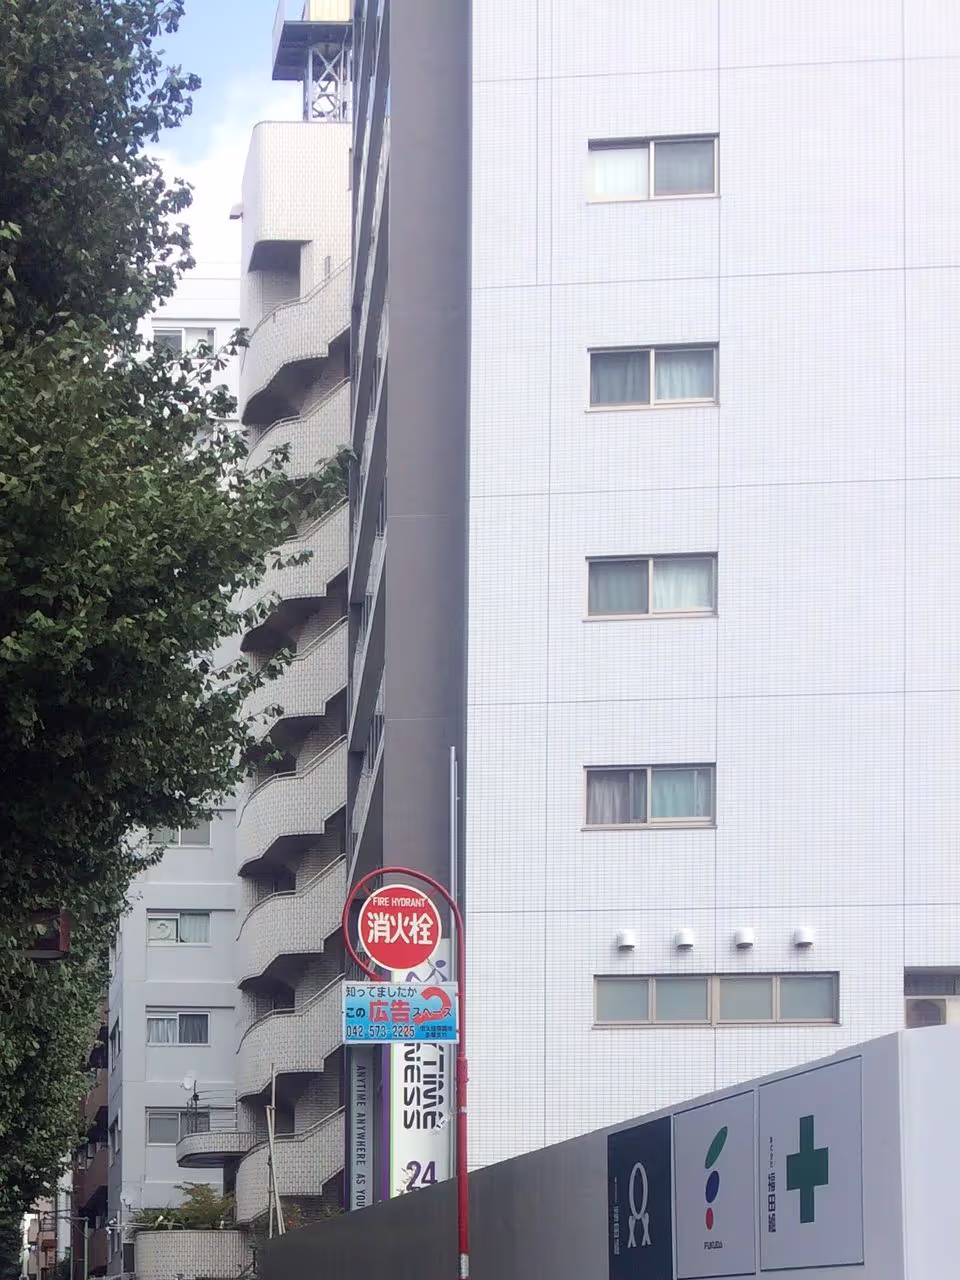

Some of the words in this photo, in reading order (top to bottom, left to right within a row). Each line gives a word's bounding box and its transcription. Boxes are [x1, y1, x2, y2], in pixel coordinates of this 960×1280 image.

[372, 896, 390, 907] FIRE
[391, 897, 426, 908] HYDRANT
[367, 911, 434, 945] 消火栓
[345, 986, 417, 998] 知ってましたか
[356, 1065, 367, 1107] ANYTIME
[356, 1112, 367, 1166] ANYWHERE
[356, 1173, 366, 1185] AS
[405, 1160, 438, 1192] 24
